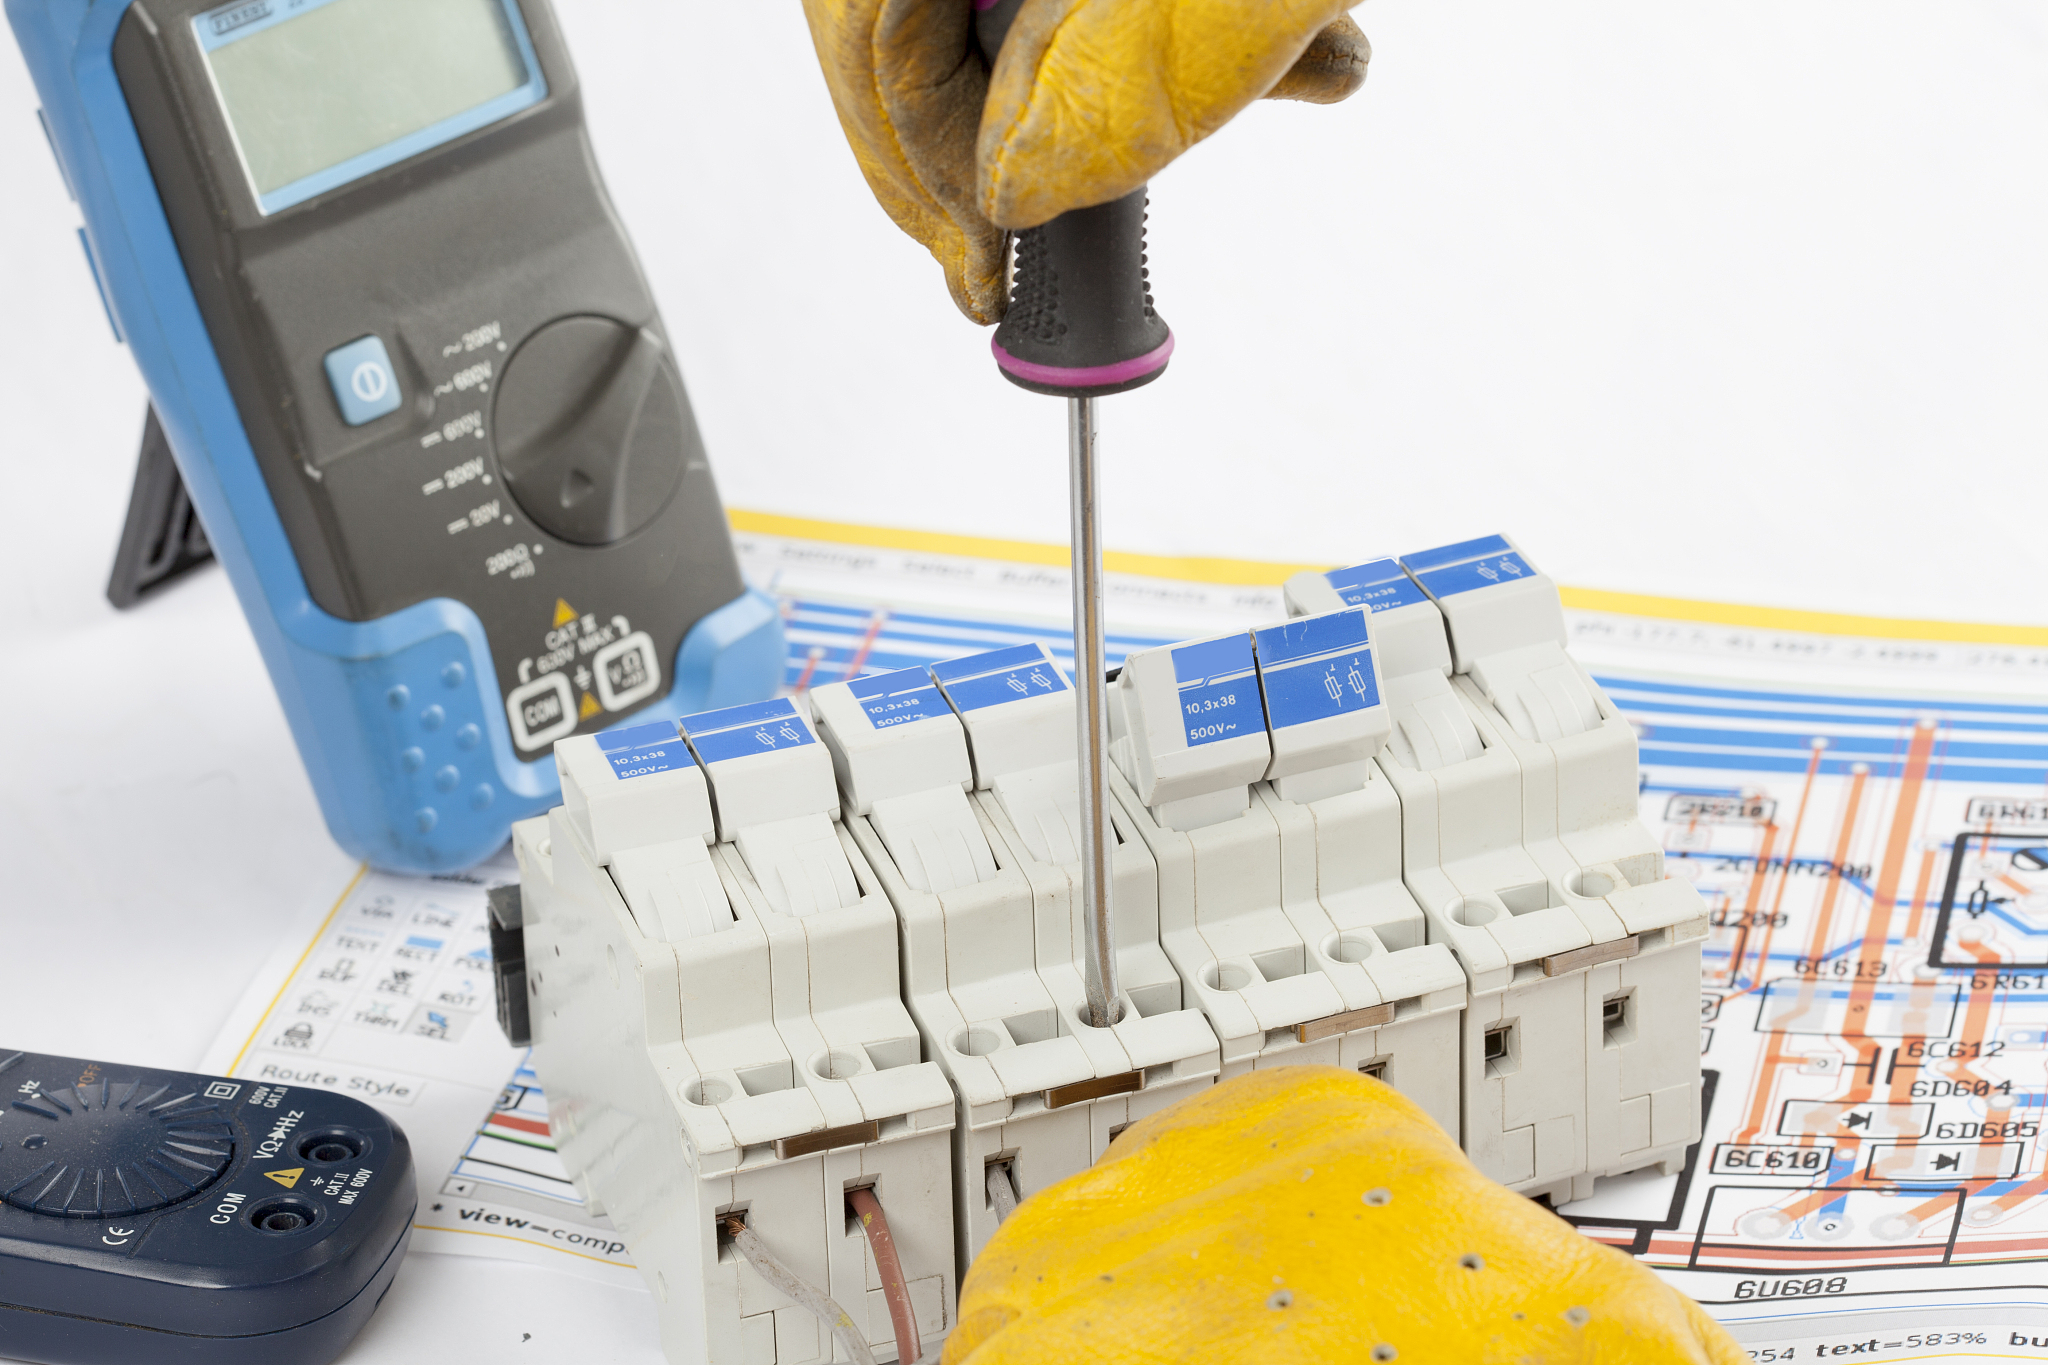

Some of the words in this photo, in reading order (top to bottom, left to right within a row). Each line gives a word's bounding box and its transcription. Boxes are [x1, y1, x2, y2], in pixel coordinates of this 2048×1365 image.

[545, 620, 579, 651] CAT
[524, 694, 562, 728] COM
[1185, 694, 1236, 715] 10,3x38
[1906, 1040, 2007, 1059] 6C612
[79, 1064, 102, 1083] OFF
[261, 1065, 338, 1087] Route
[347, 1076, 411, 1097] Style
[18, 1080, 41, 1094] Hz
[249, 1086, 271, 1105] 600V
[1723, 1149, 1821, 1169] 6C610
[338, 1190, 360, 1206] MAX
[350, 1168, 374, 1188] 600V
[210, 1192, 247, 1225] COM
[1815, 1332, 1988, 1359] text=583%
